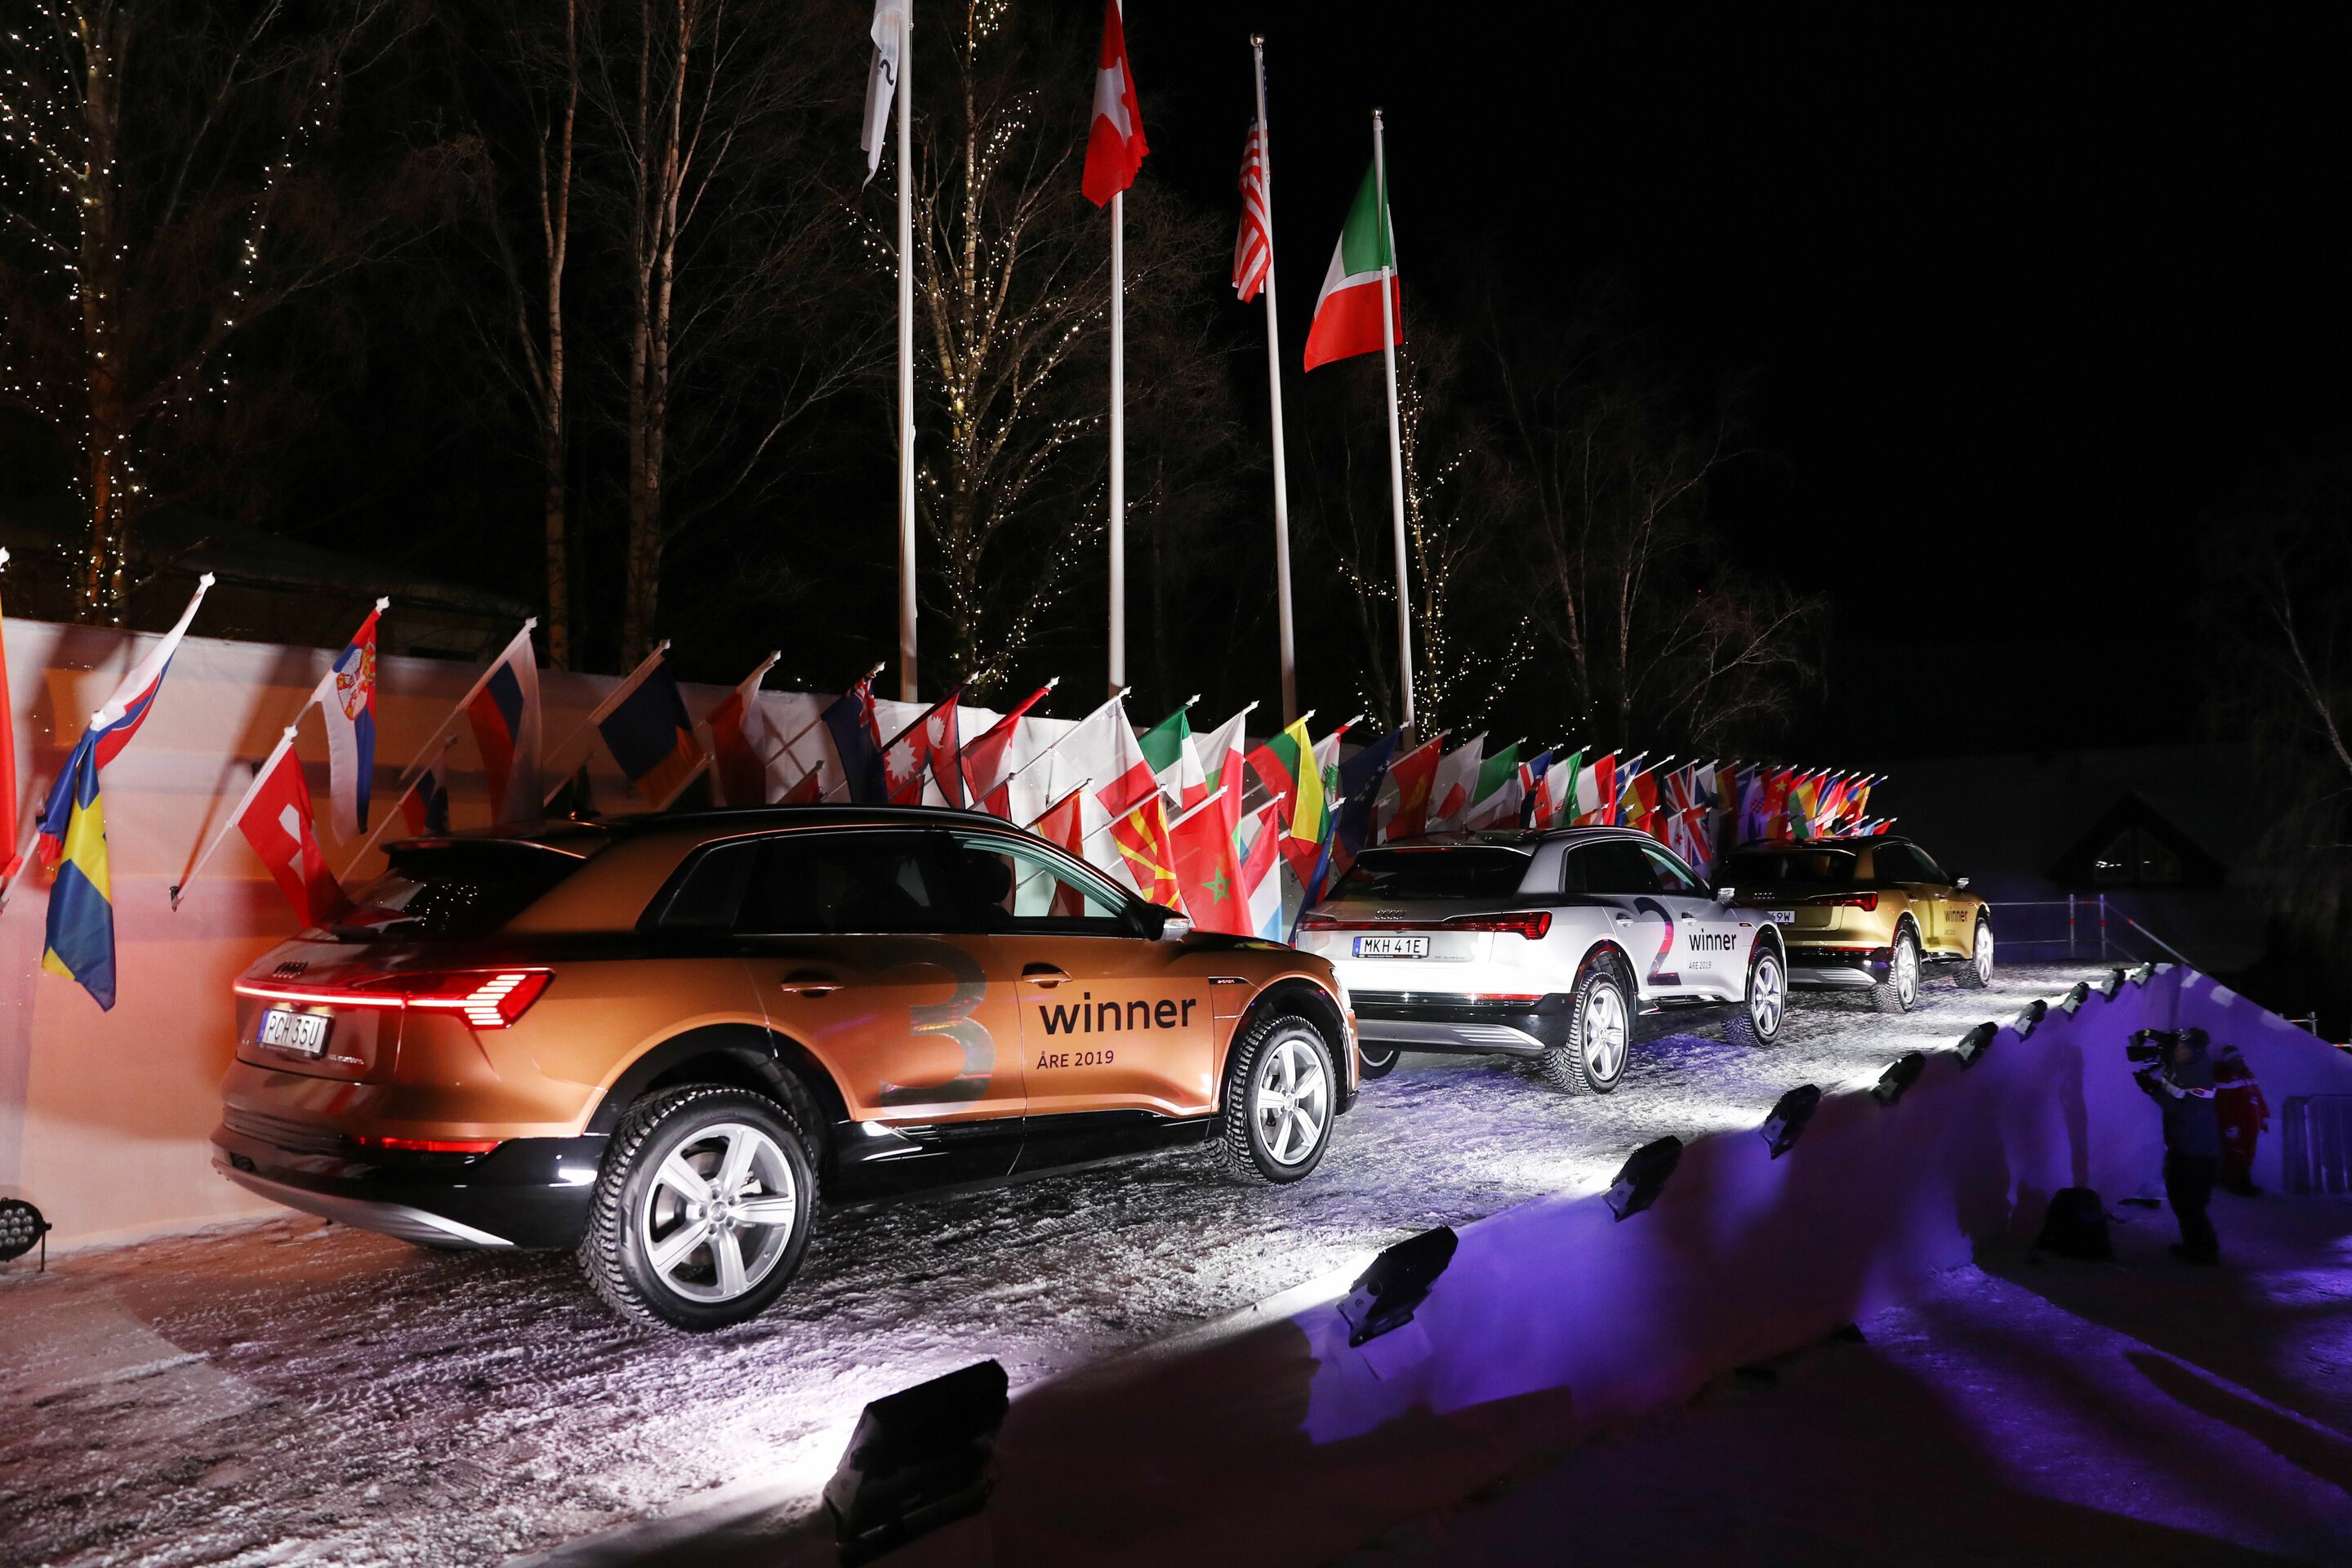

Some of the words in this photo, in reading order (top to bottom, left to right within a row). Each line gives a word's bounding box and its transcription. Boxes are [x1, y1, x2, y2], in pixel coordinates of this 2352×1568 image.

[1944, 906, 1967, 922] winner
[1364, 939, 1390, 953] MKH
[1394, 939, 1421, 954] 41E
[1633, 897, 1682, 986] 2
[1689, 928, 1737, 951] winner
[1699, 961, 1712, 969] 2019
[1039, 991, 1196, 1035] winner
[266, 1015, 292, 1044] PCH
[292, 1018, 321, 1047] 35U
[875, 936, 996, 1117] 3
[1036, 1050, 1070, 1070] ÅRE
[1074, 1050, 1115, 1066] 2019
